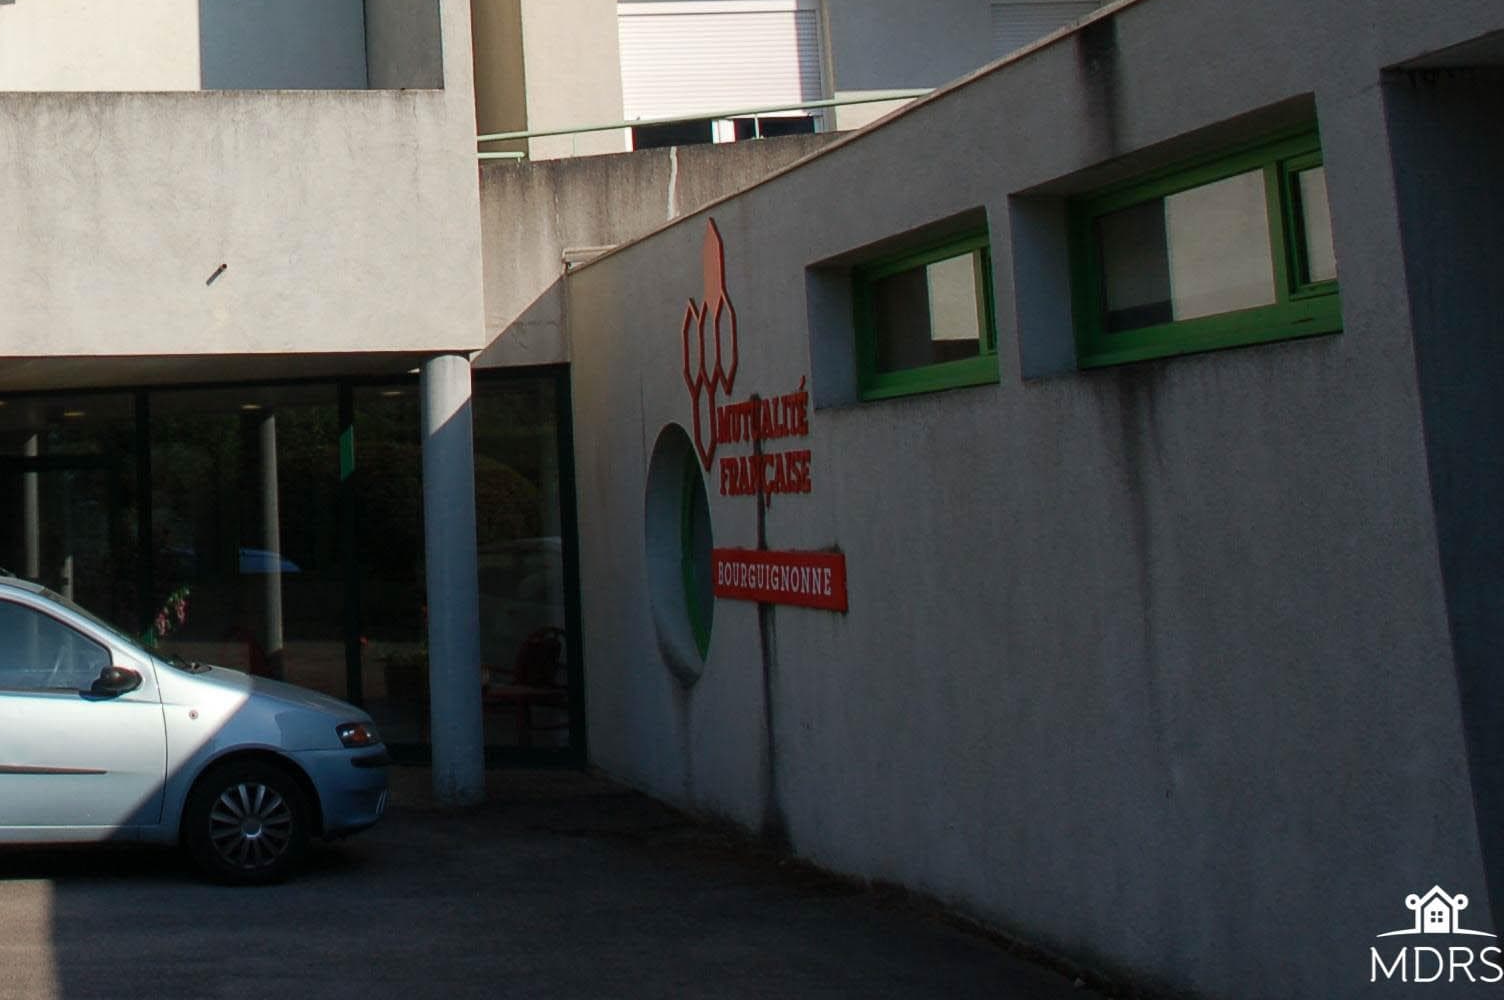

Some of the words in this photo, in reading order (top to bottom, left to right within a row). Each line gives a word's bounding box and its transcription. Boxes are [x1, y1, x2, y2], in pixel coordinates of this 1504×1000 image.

[716, 375, 809, 444] MUTUALITÉ
[719, 449, 811, 509] FRANÇAISE
[718, 560, 832, 596] BOURGUIGNONNE
